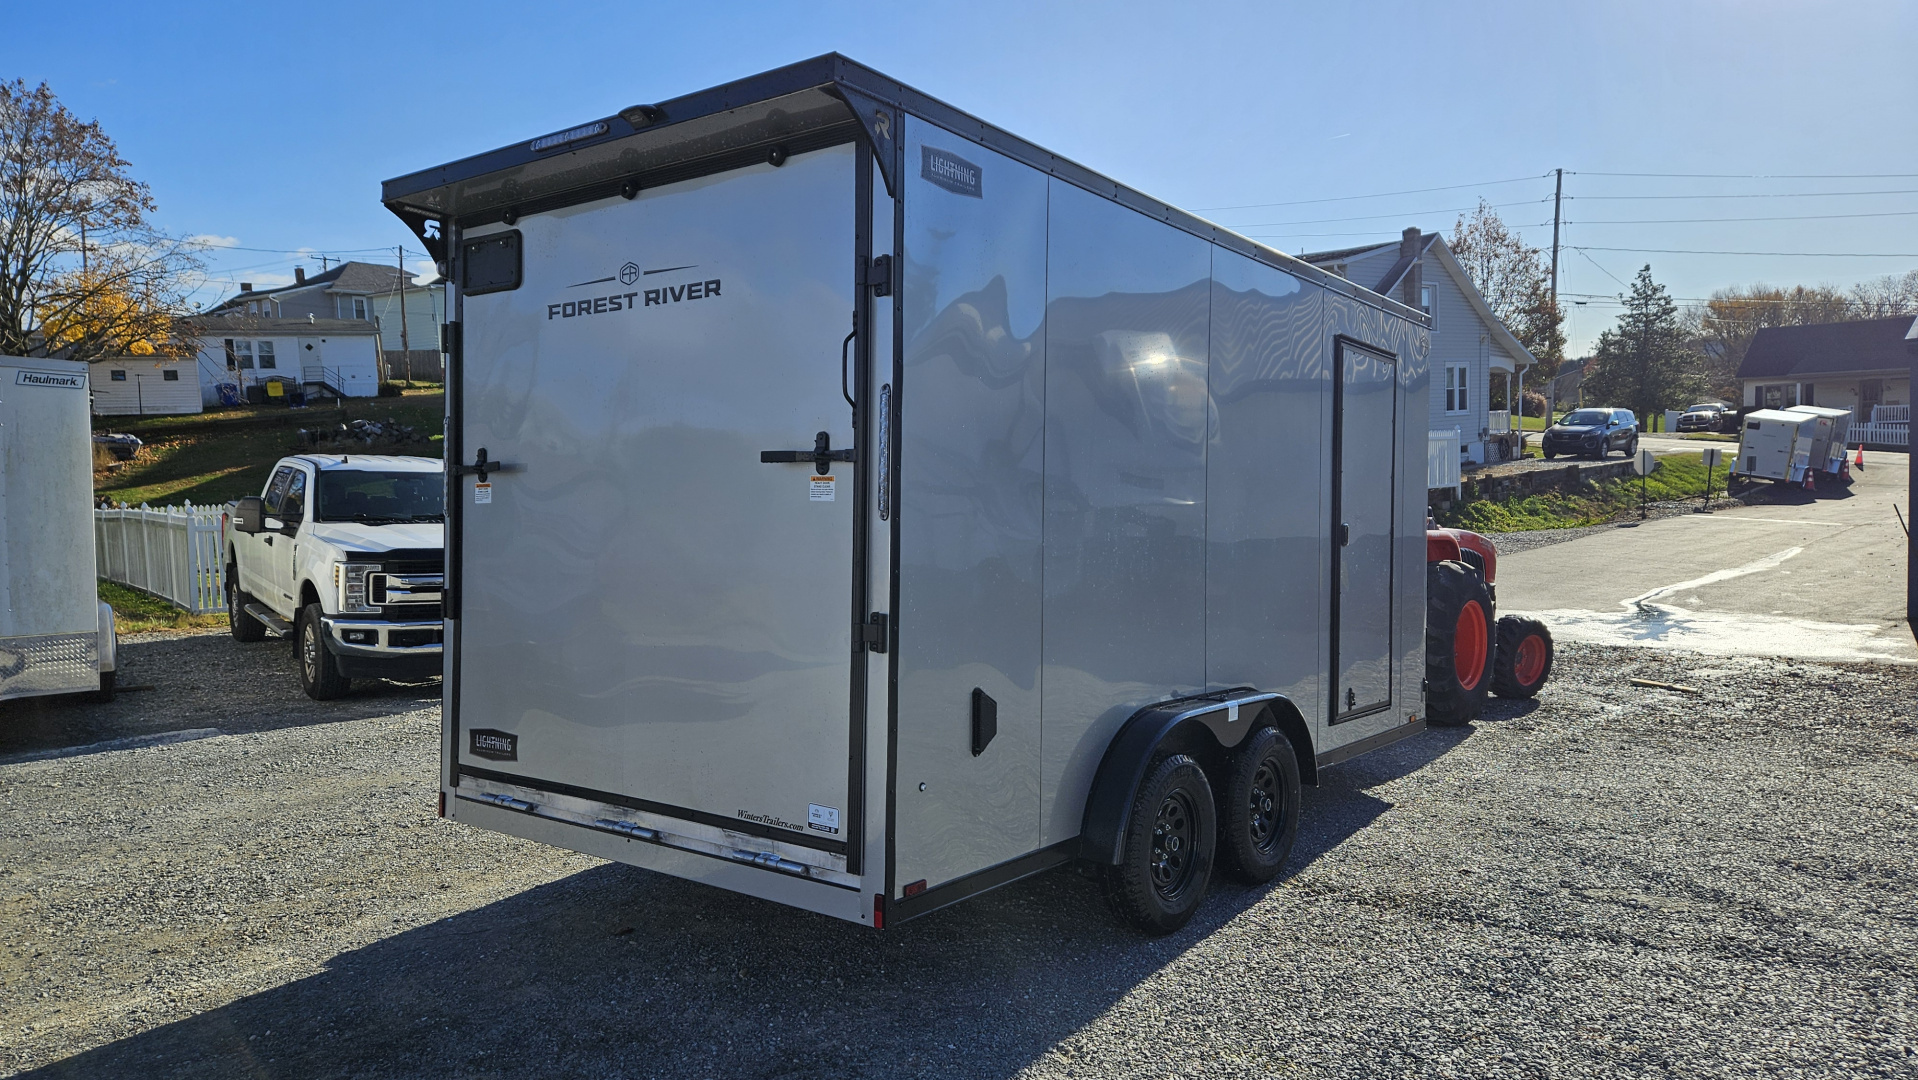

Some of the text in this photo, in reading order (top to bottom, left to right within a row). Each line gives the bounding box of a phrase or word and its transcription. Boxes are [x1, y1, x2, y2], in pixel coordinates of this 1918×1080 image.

[930, 154, 975, 185] LIGHTNING
[547, 279, 722, 320] FOREST RIVER
[476, 734, 512, 752] LIGHTNING
[737, 809, 804, 831] WintersTrailers.com
